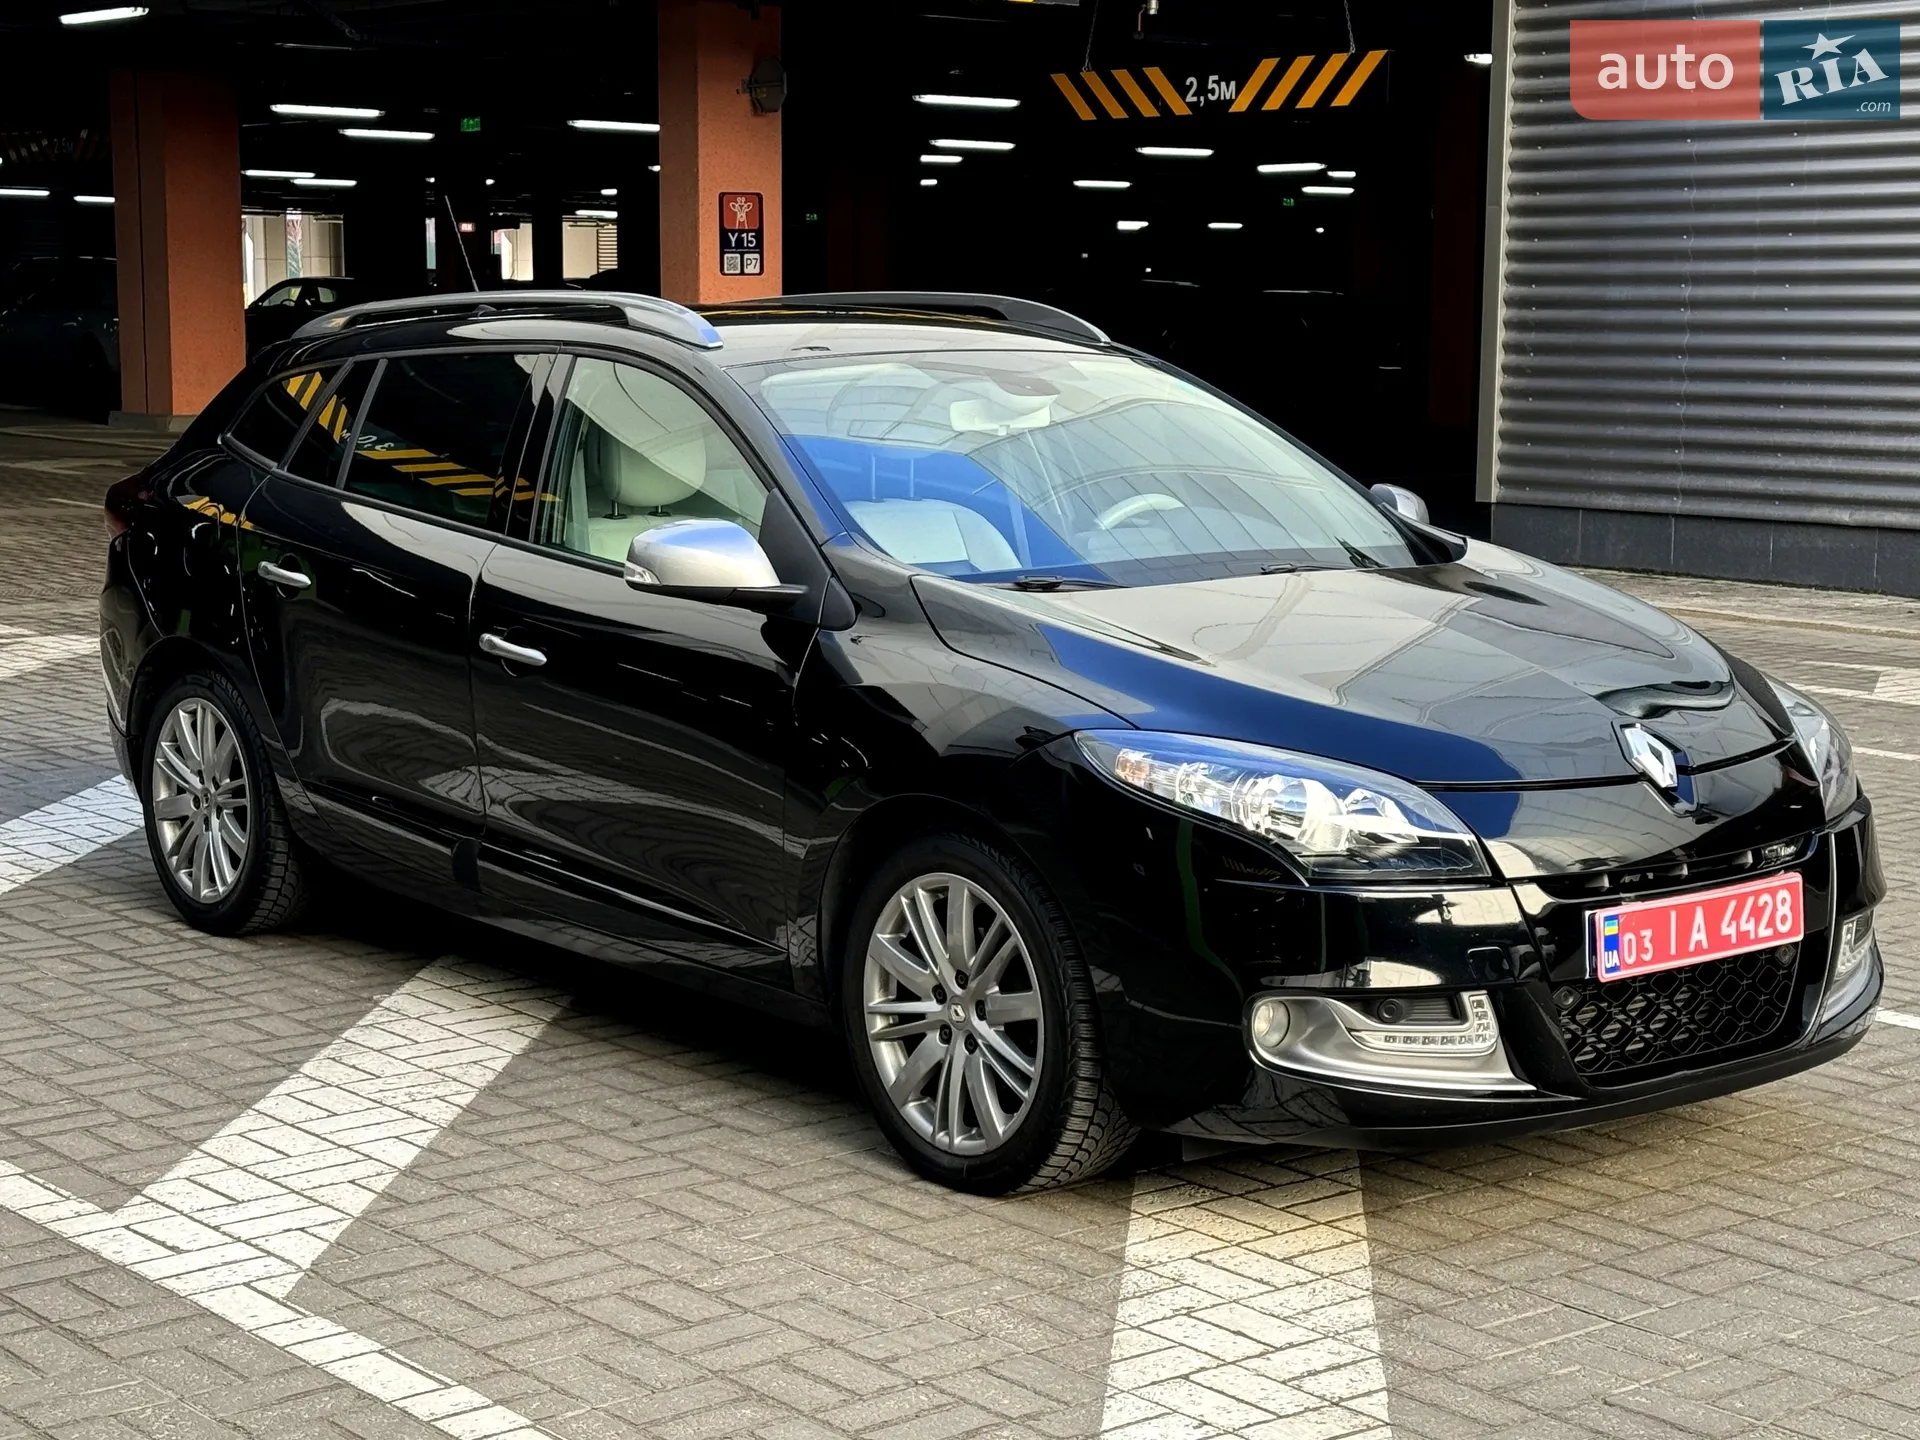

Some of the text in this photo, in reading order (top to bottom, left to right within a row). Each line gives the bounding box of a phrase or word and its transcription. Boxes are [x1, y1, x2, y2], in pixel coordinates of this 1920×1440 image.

[727, 232, 757, 247] Y 15
[745, 257, 759, 270] P7
[1623, 929, 1653, 965] 03
[1720, 888, 1793, 945] 4428
[1604, 949, 1620, 968] UA
